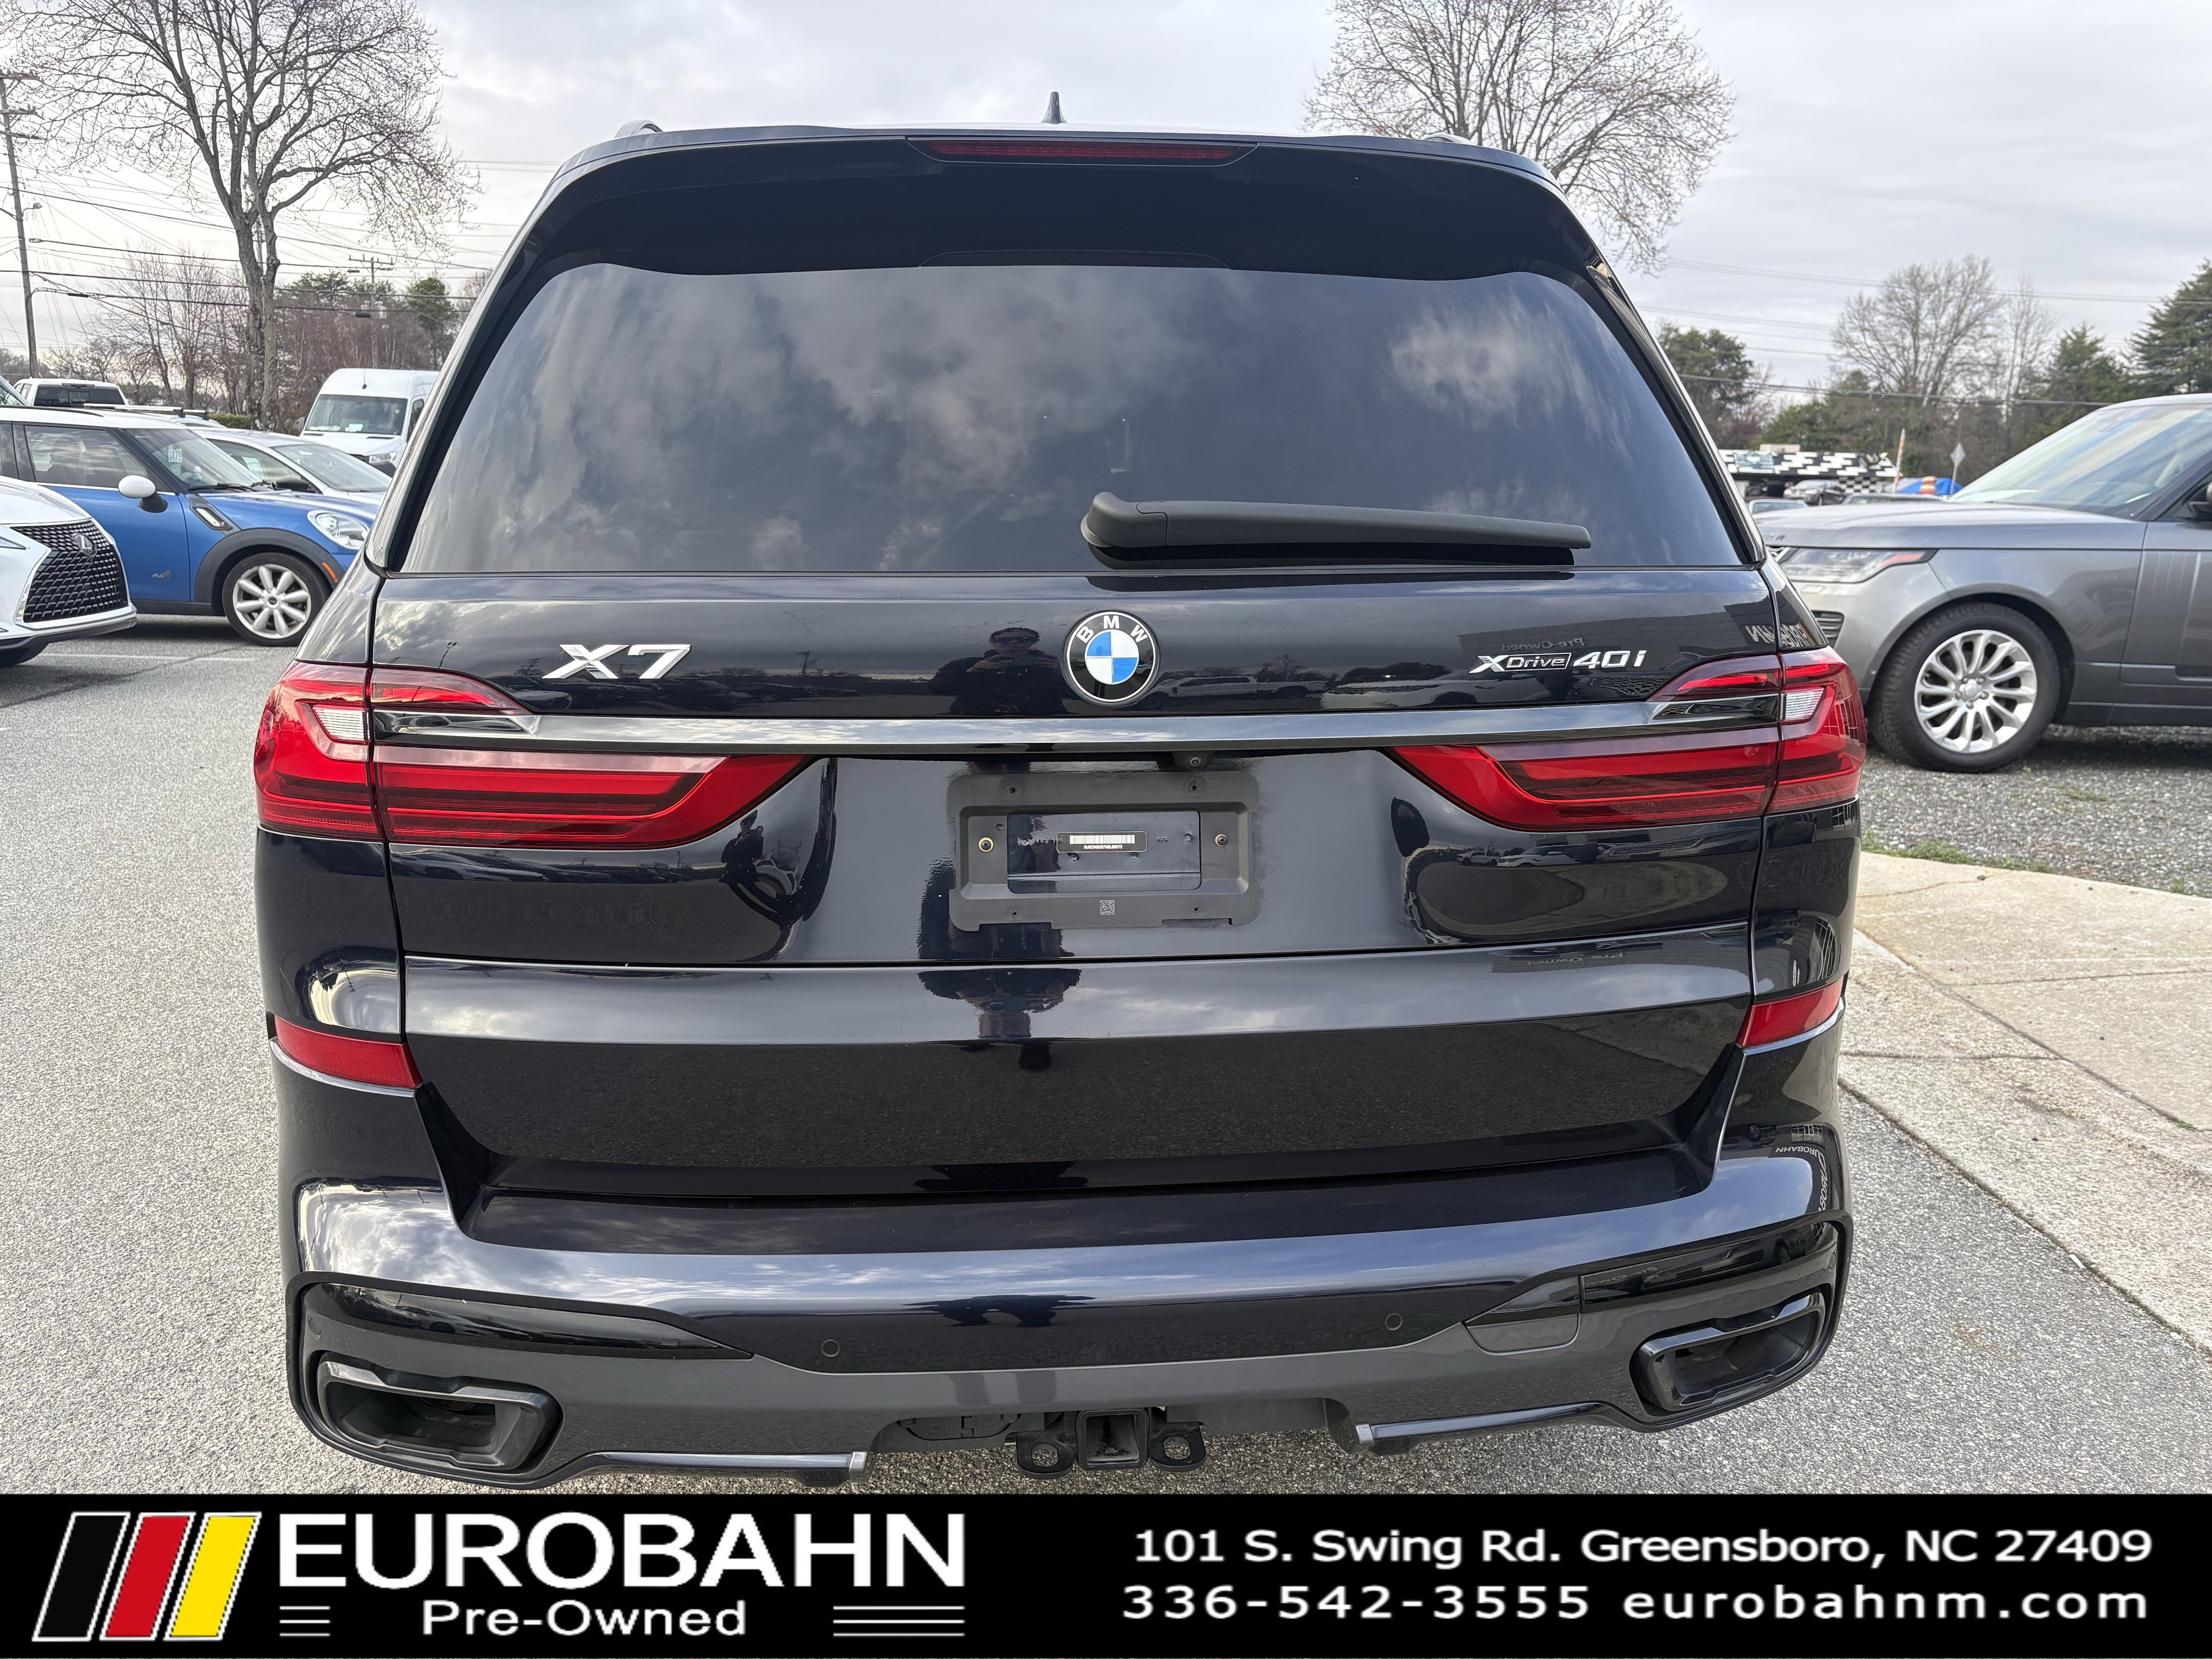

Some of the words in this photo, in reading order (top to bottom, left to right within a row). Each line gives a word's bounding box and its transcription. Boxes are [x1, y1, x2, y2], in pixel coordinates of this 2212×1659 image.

[170, 450, 181, 461] 1479
[1076, 615, 1148, 644] BMW
[542, 644, 691, 679] X7
